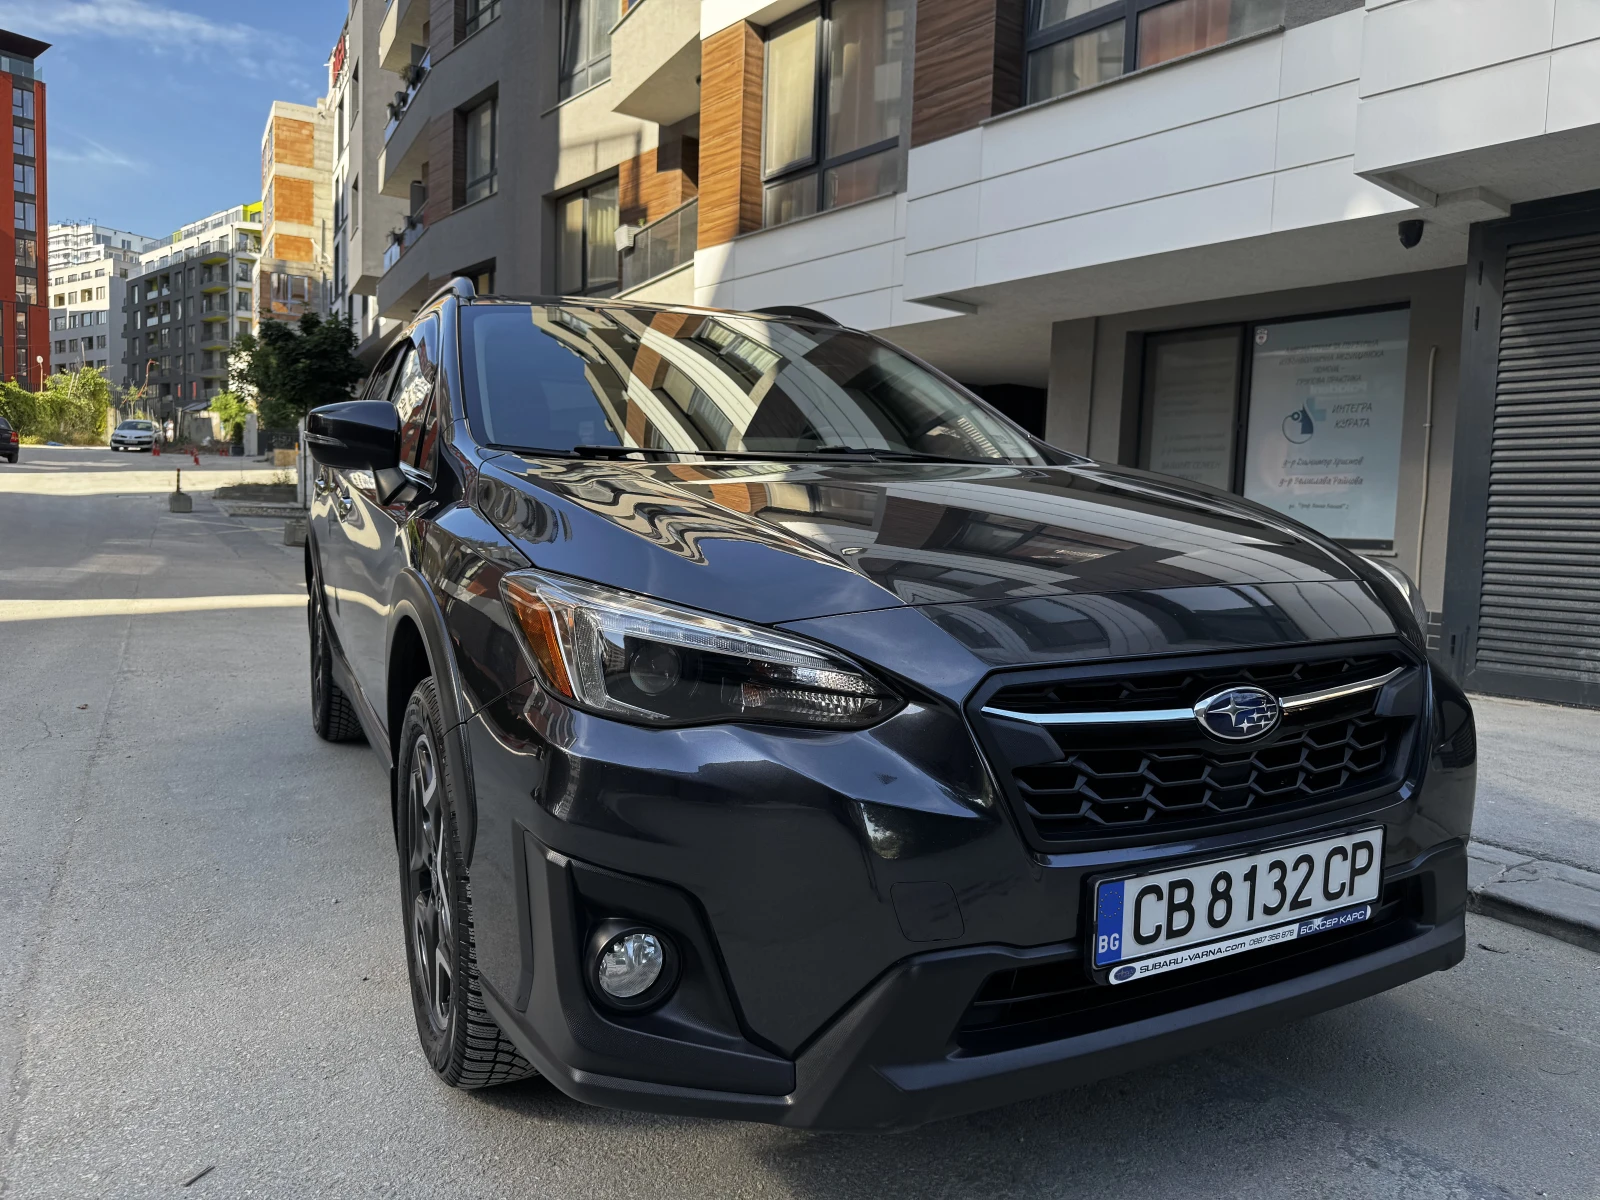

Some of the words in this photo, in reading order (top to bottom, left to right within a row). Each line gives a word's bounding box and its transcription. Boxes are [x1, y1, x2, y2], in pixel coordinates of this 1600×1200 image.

[1331, 402, 1373, 414] ИНТЕГРА
[1334, 418, 1371, 429] КУРАТА
[1132, 877, 1195, 946] CB
[1206, 853, 1315, 929] 8132
[1322, 839, 1374, 901] CP
[1300, 917, 1338, 935] БОКСЕР
[1339, 910, 1365, 925] КАРС
[1098, 932, 1120, 954] BG
[1139, 941, 1246, 974] SUBARU-VARNA.com
